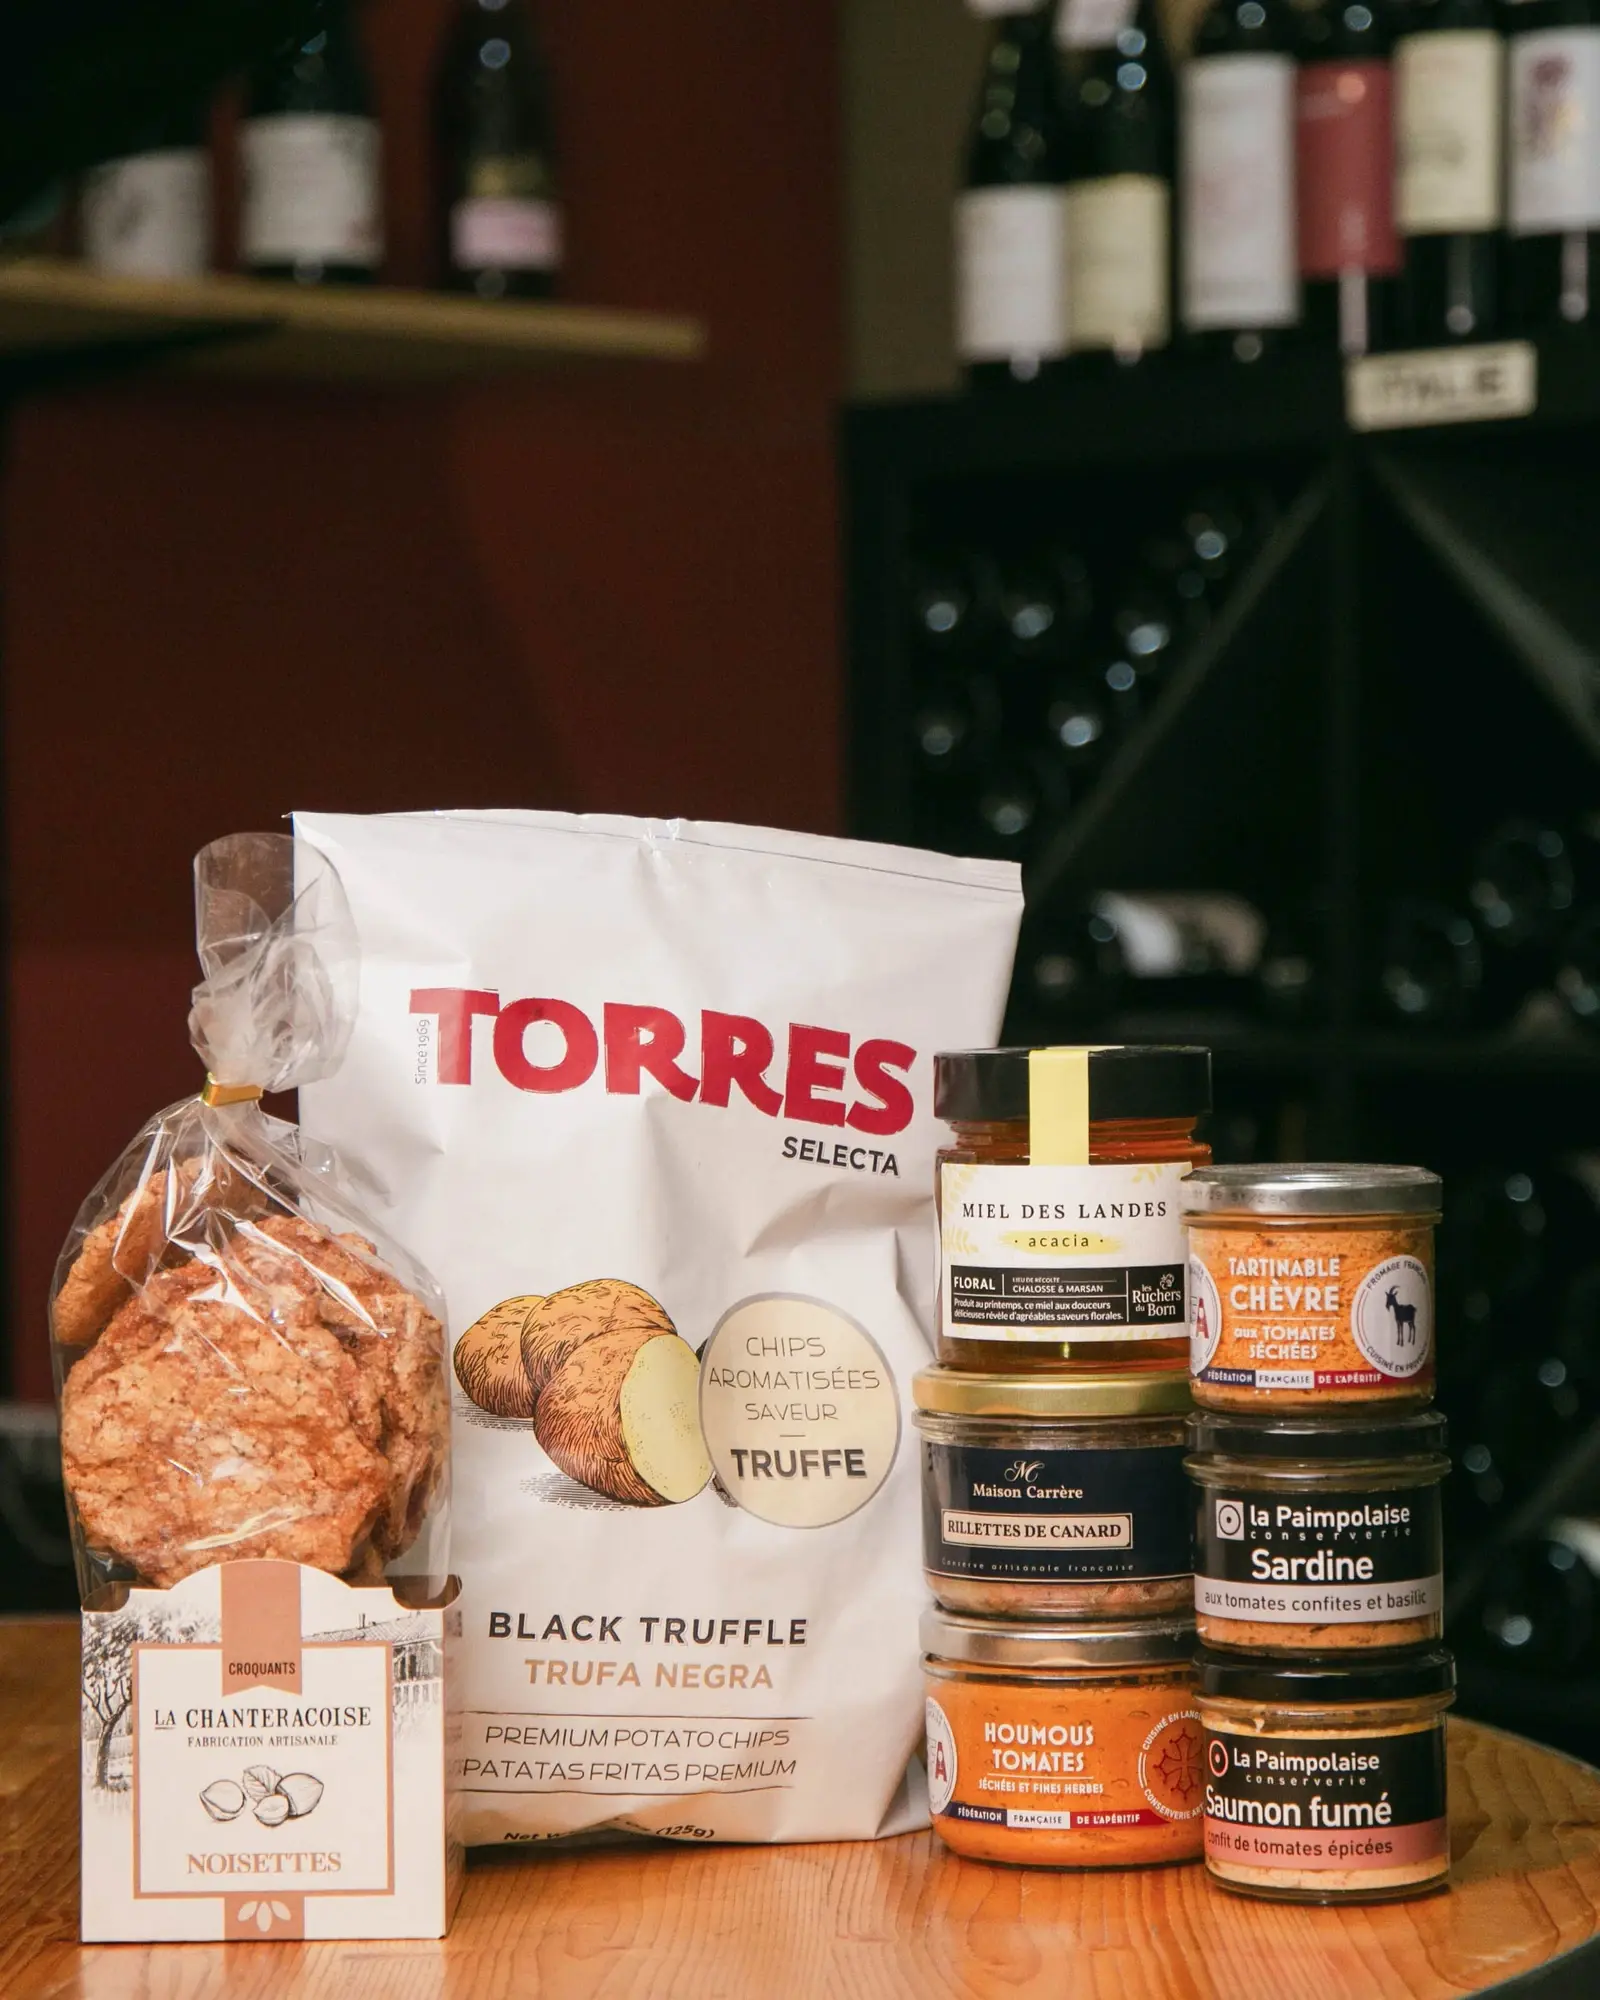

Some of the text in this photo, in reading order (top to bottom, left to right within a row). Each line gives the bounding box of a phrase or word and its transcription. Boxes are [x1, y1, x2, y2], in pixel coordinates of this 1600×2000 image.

[409, 987, 917, 1137] TORRES
[415, 1019, 431, 1085] Since 1969
[782, 1135, 900, 1176] SELECTA
[962, 1201, 1168, 1219] MIEL DES LANDES
[1028, 1233, 1090, 1248] acacia
[1228, 1257, 1340, 1277] TARTINABLE
[1366, 1261, 1401, 1290] FROMAGE
[953, 1276, 996, 1291] FLORAL
[1012, 1285, 1103, 1293] CHALOSSE & MARSAN
[1142, 1284, 1152, 1292] les
[954, 1299, 974, 1309] Produit
[984, 1300, 1023, 1312] printemps,
[1035, 1301, 1053, 1310] miel
[1071, 1300, 1111, 1310] douceurs
[1132, 1290, 1181, 1303] Ruchers
[1229, 1280, 1340, 1311] CHÈVRE
[1009, 1311, 1055, 1322] d'agréables
[1057, 1312, 1089, 1321] saveurs
[1090, 1311, 1124, 1320] florales.
[1148, 1303, 1175, 1316] Born
[1233, 1325, 1336, 1341] aux TOMATES
[746, 1337, 826, 1358] CHIPS
[1248, 1342, 1318, 1360] SÉCHÉES
[708, 1366, 881, 1390] AROMATISÉES
[1207, 1369, 1382, 1385] FÉDÉRATION FRANÇAISE DE L'APÉRITIF
[745, 1403, 839, 1421] SAVEUR
[730, 1448, 867, 1479] TRUFFE
[972, 1483, 1084, 1499] Maison Carrère
[1250, 1503, 1411, 1532] la Paimpolaise
[948, 1519, 1122, 1538] RILLETTES DE CANARD
[1250, 1527, 1412, 1541] conserverie
[991, 1562, 1060, 1573] artisanale
[1068, 1562, 1135, 1574] française
[1251, 1548, 1374, 1581] Sardine
[1204, 1588, 1427, 1611] aux tomates confites et basilic
[488, 1611, 808, 1646] BLACK TRUFFLE
[228, 1662, 296, 1677] CROQUANTS
[524, 1659, 774, 1689] TRUFA NEGRA
[154, 1706, 372, 1729] LA CHANTERACOISE
[187, 1735, 338, 1748] FABRICATION ARTISANALE
[485, 1726, 790, 1749] PREMIUM POTATO CHIPS
[984, 1722, 1094, 1746] HOUMOUS
[1142, 1717, 1168, 1751] CUISINÉ
[1168, 1713, 1180, 1723] EN
[463, 1759, 797, 1782] PATATAS FRITAS PREMIUM
[992, 1748, 1084, 1773] TOMATES
[1233, 1747, 1380, 1776] La Paimpolaise
[978, 1777, 1104, 1794] SÉCHÉES ET FINES HERBES
[1246, 1774, 1367, 1787] conserverie
[1144, 1788, 1191, 1820] CONSERVERIE
[1206, 1784, 1392, 1827] Saumon fumé
[957, 1806, 1140, 1825] FÉDÉRATION FRANÇAISE DE L'APÉRITIF
[1207, 1830, 1393, 1860] confit de tomates épicées
[186, 1851, 342, 1875] NOISETTES
